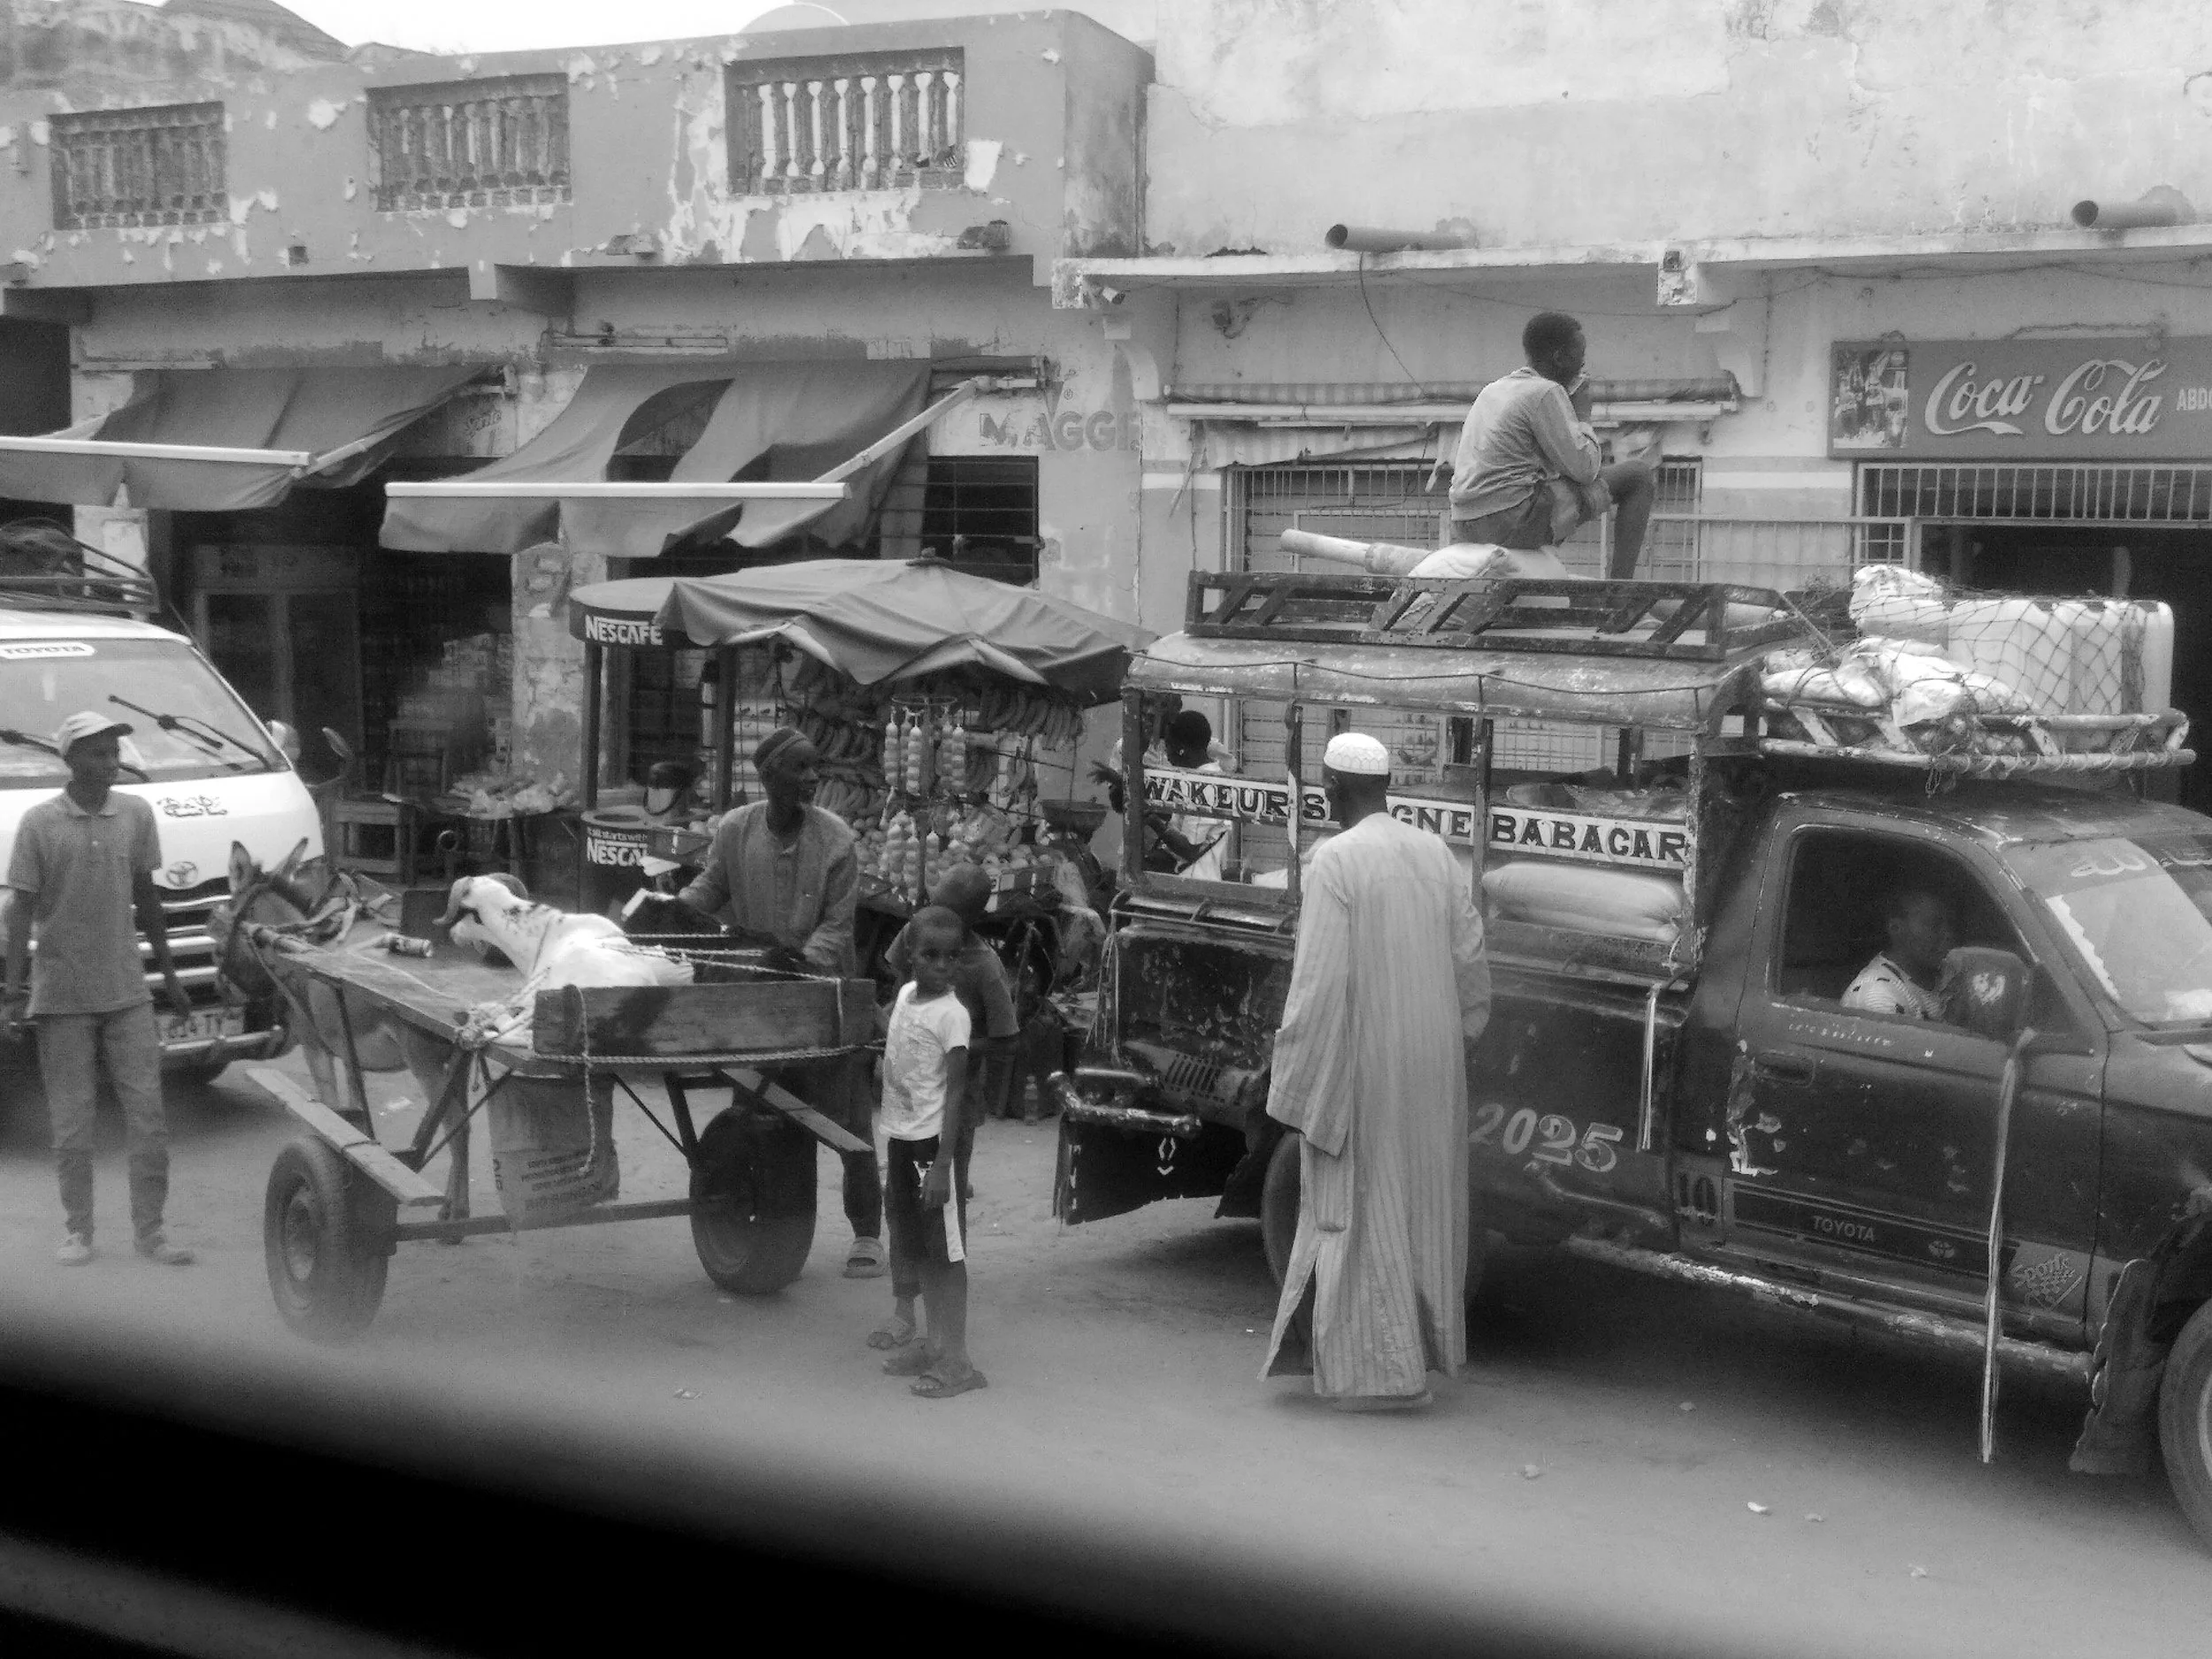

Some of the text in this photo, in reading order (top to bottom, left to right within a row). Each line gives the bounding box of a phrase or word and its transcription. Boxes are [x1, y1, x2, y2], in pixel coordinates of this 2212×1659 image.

[1492, 814, 1686, 863] BABACAR
[1469, 1103, 1624, 1172] 2025
[1813, 1215, 1875, 1242] TOYOTA
